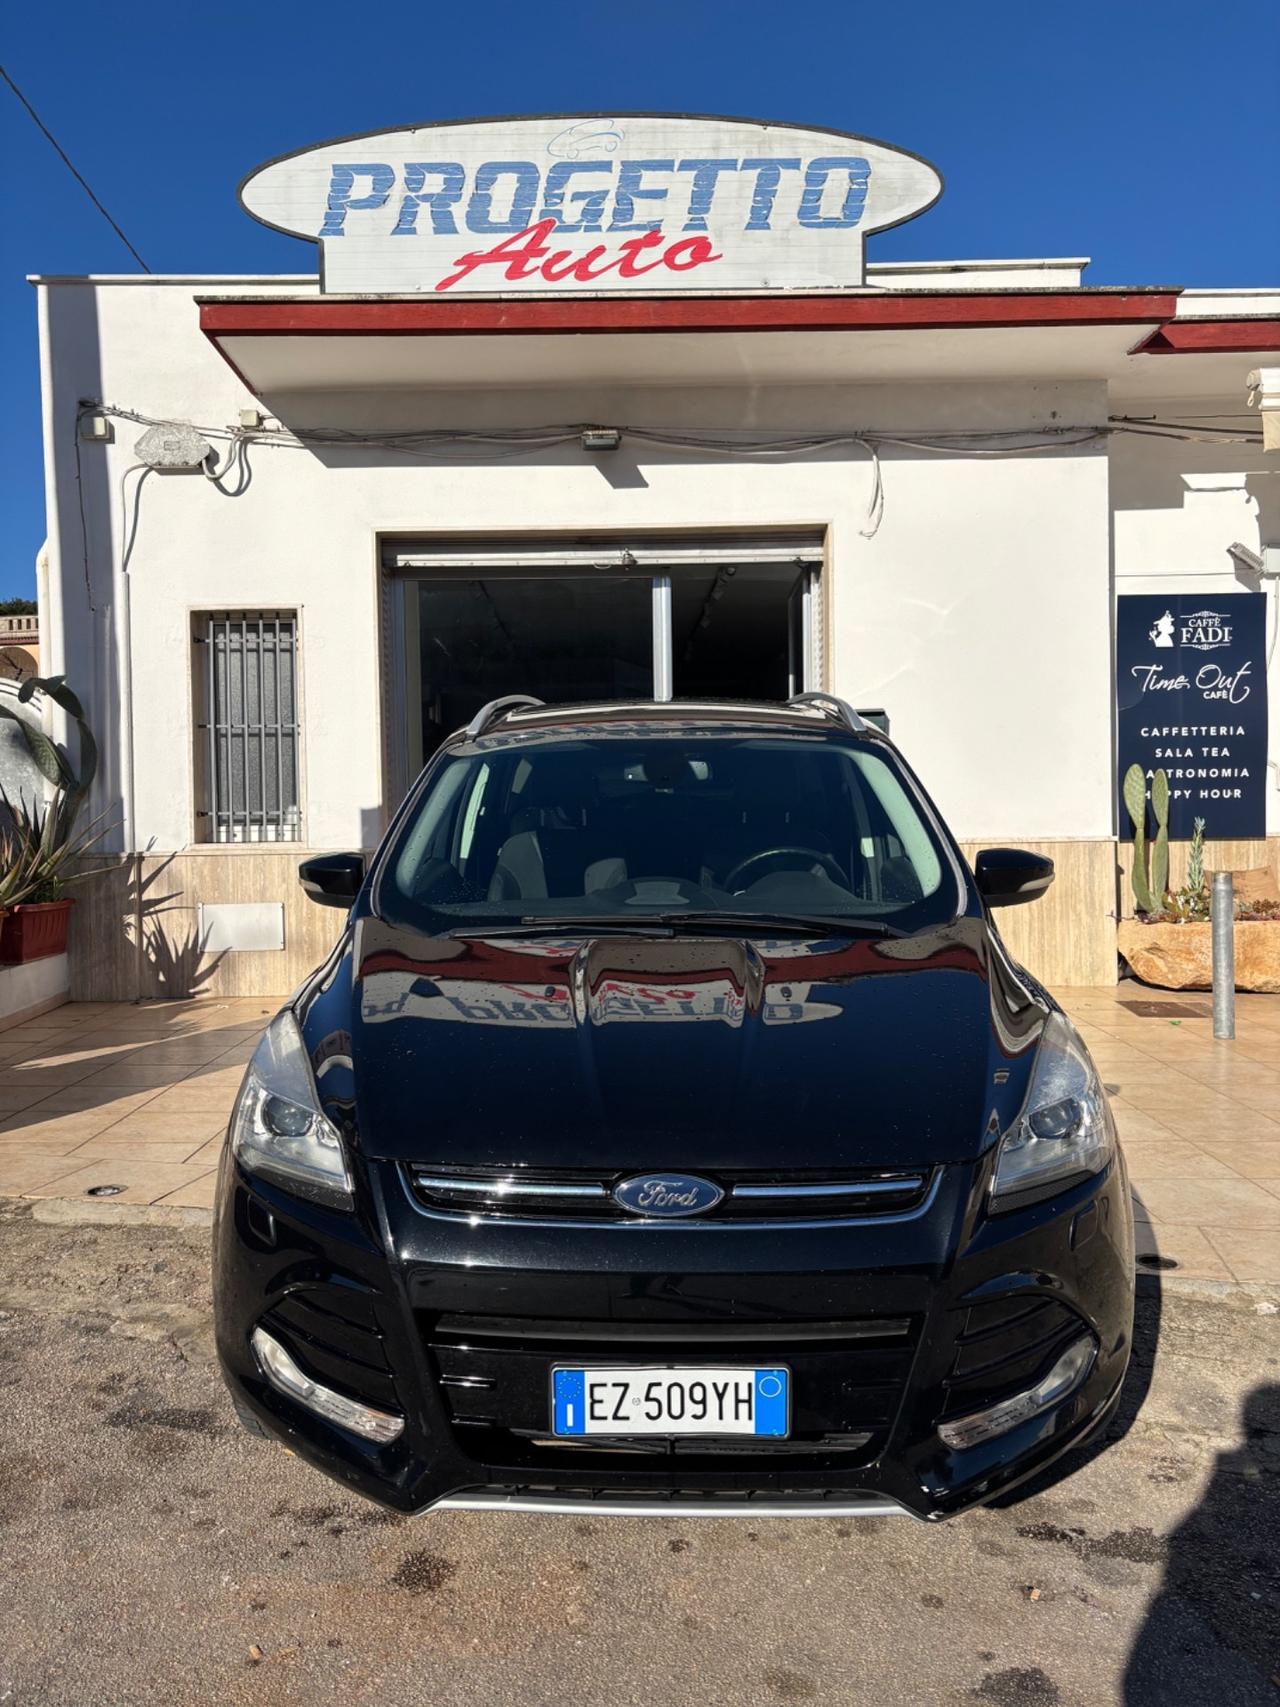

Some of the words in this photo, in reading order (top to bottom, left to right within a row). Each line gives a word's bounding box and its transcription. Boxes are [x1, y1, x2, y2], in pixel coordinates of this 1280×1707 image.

[318, 156, 872, 237] PROGETTO
[434, 217, 723, 291] Auto
[1181, 627, 1230, 643] FADI
[1131, 664, 1191, 692] Time
[1196, 661, 1252, 704] Out
[1140, 726, 1245, 737] CAFFETTERIA
[1155, 748, 1193, 758] SALA
[1202, 747, 1230, 757] TEA
[1145, 768, 1250, 779] ATRONOMIA
[1199, 788, 1242, 799] HOUR
[638, 1180, 699, 1206] Ford
[589, 1382, 630, 1420] EZ
[644, 1381, 753, 1421] 509YH
